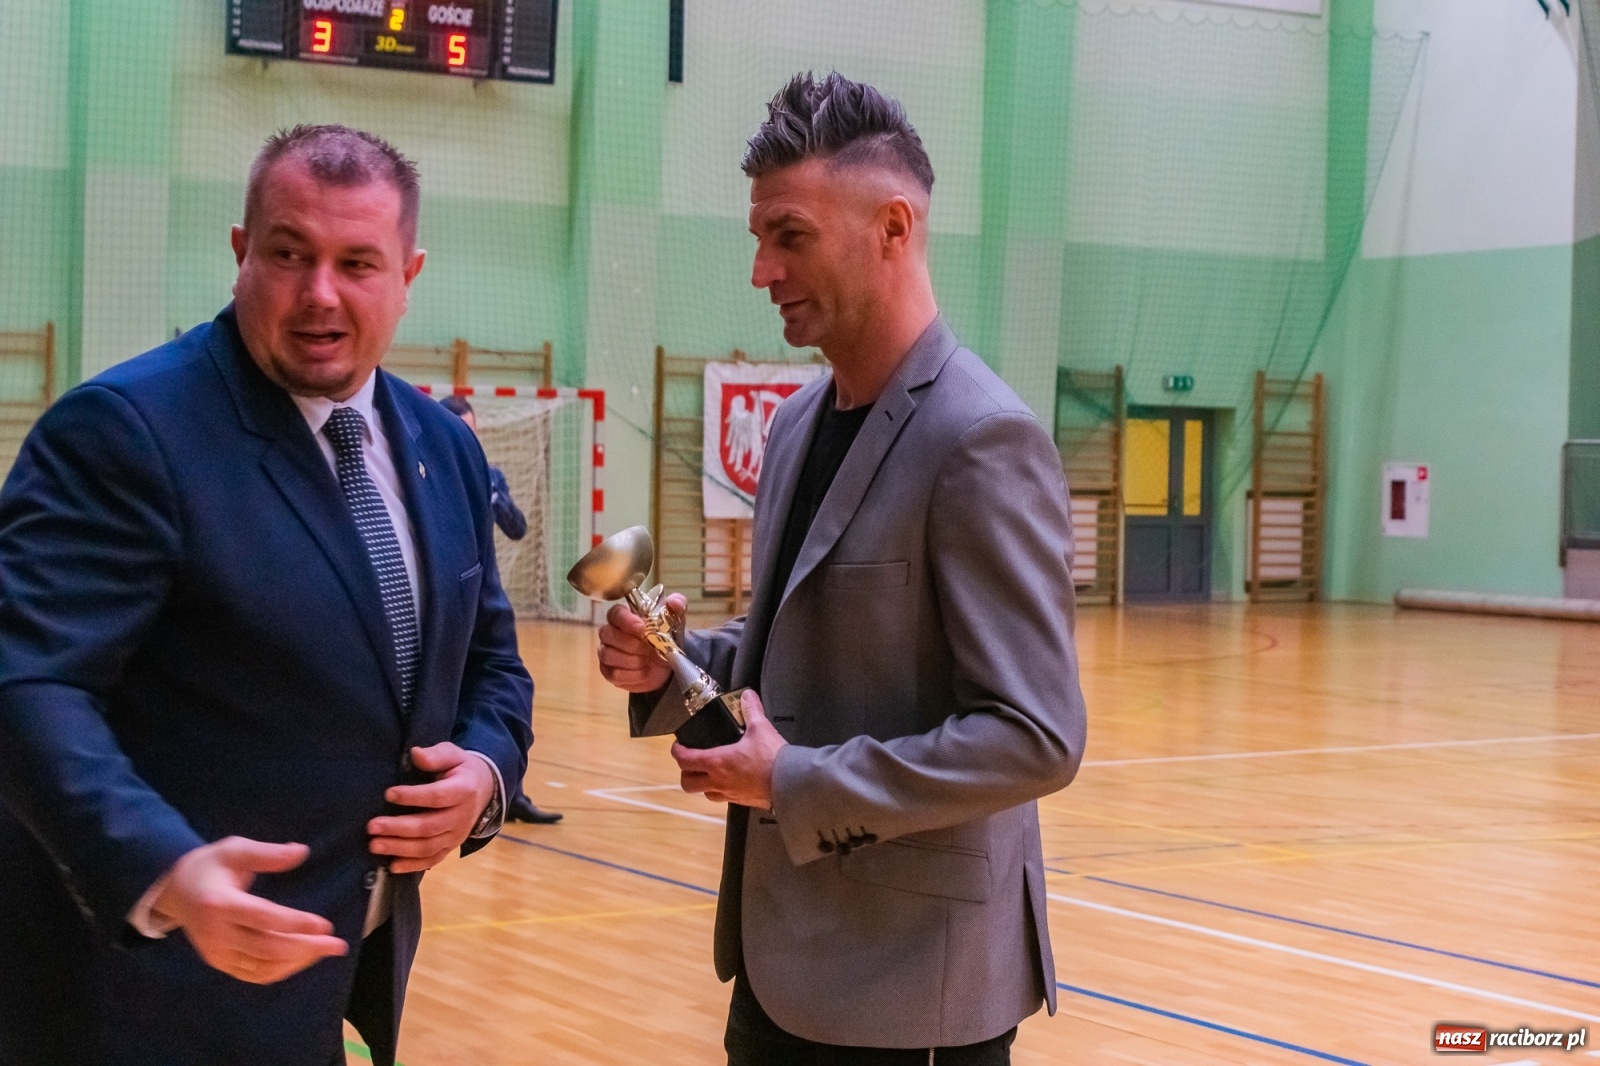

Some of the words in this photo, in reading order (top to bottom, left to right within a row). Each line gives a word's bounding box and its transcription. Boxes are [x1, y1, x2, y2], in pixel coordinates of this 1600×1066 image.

[389, 8, 405, 31] 2
[428, 2, 474, 27] GOŚCIE
[312, 20, 332, 52] 3
[448, 34, 467, 66] 5
